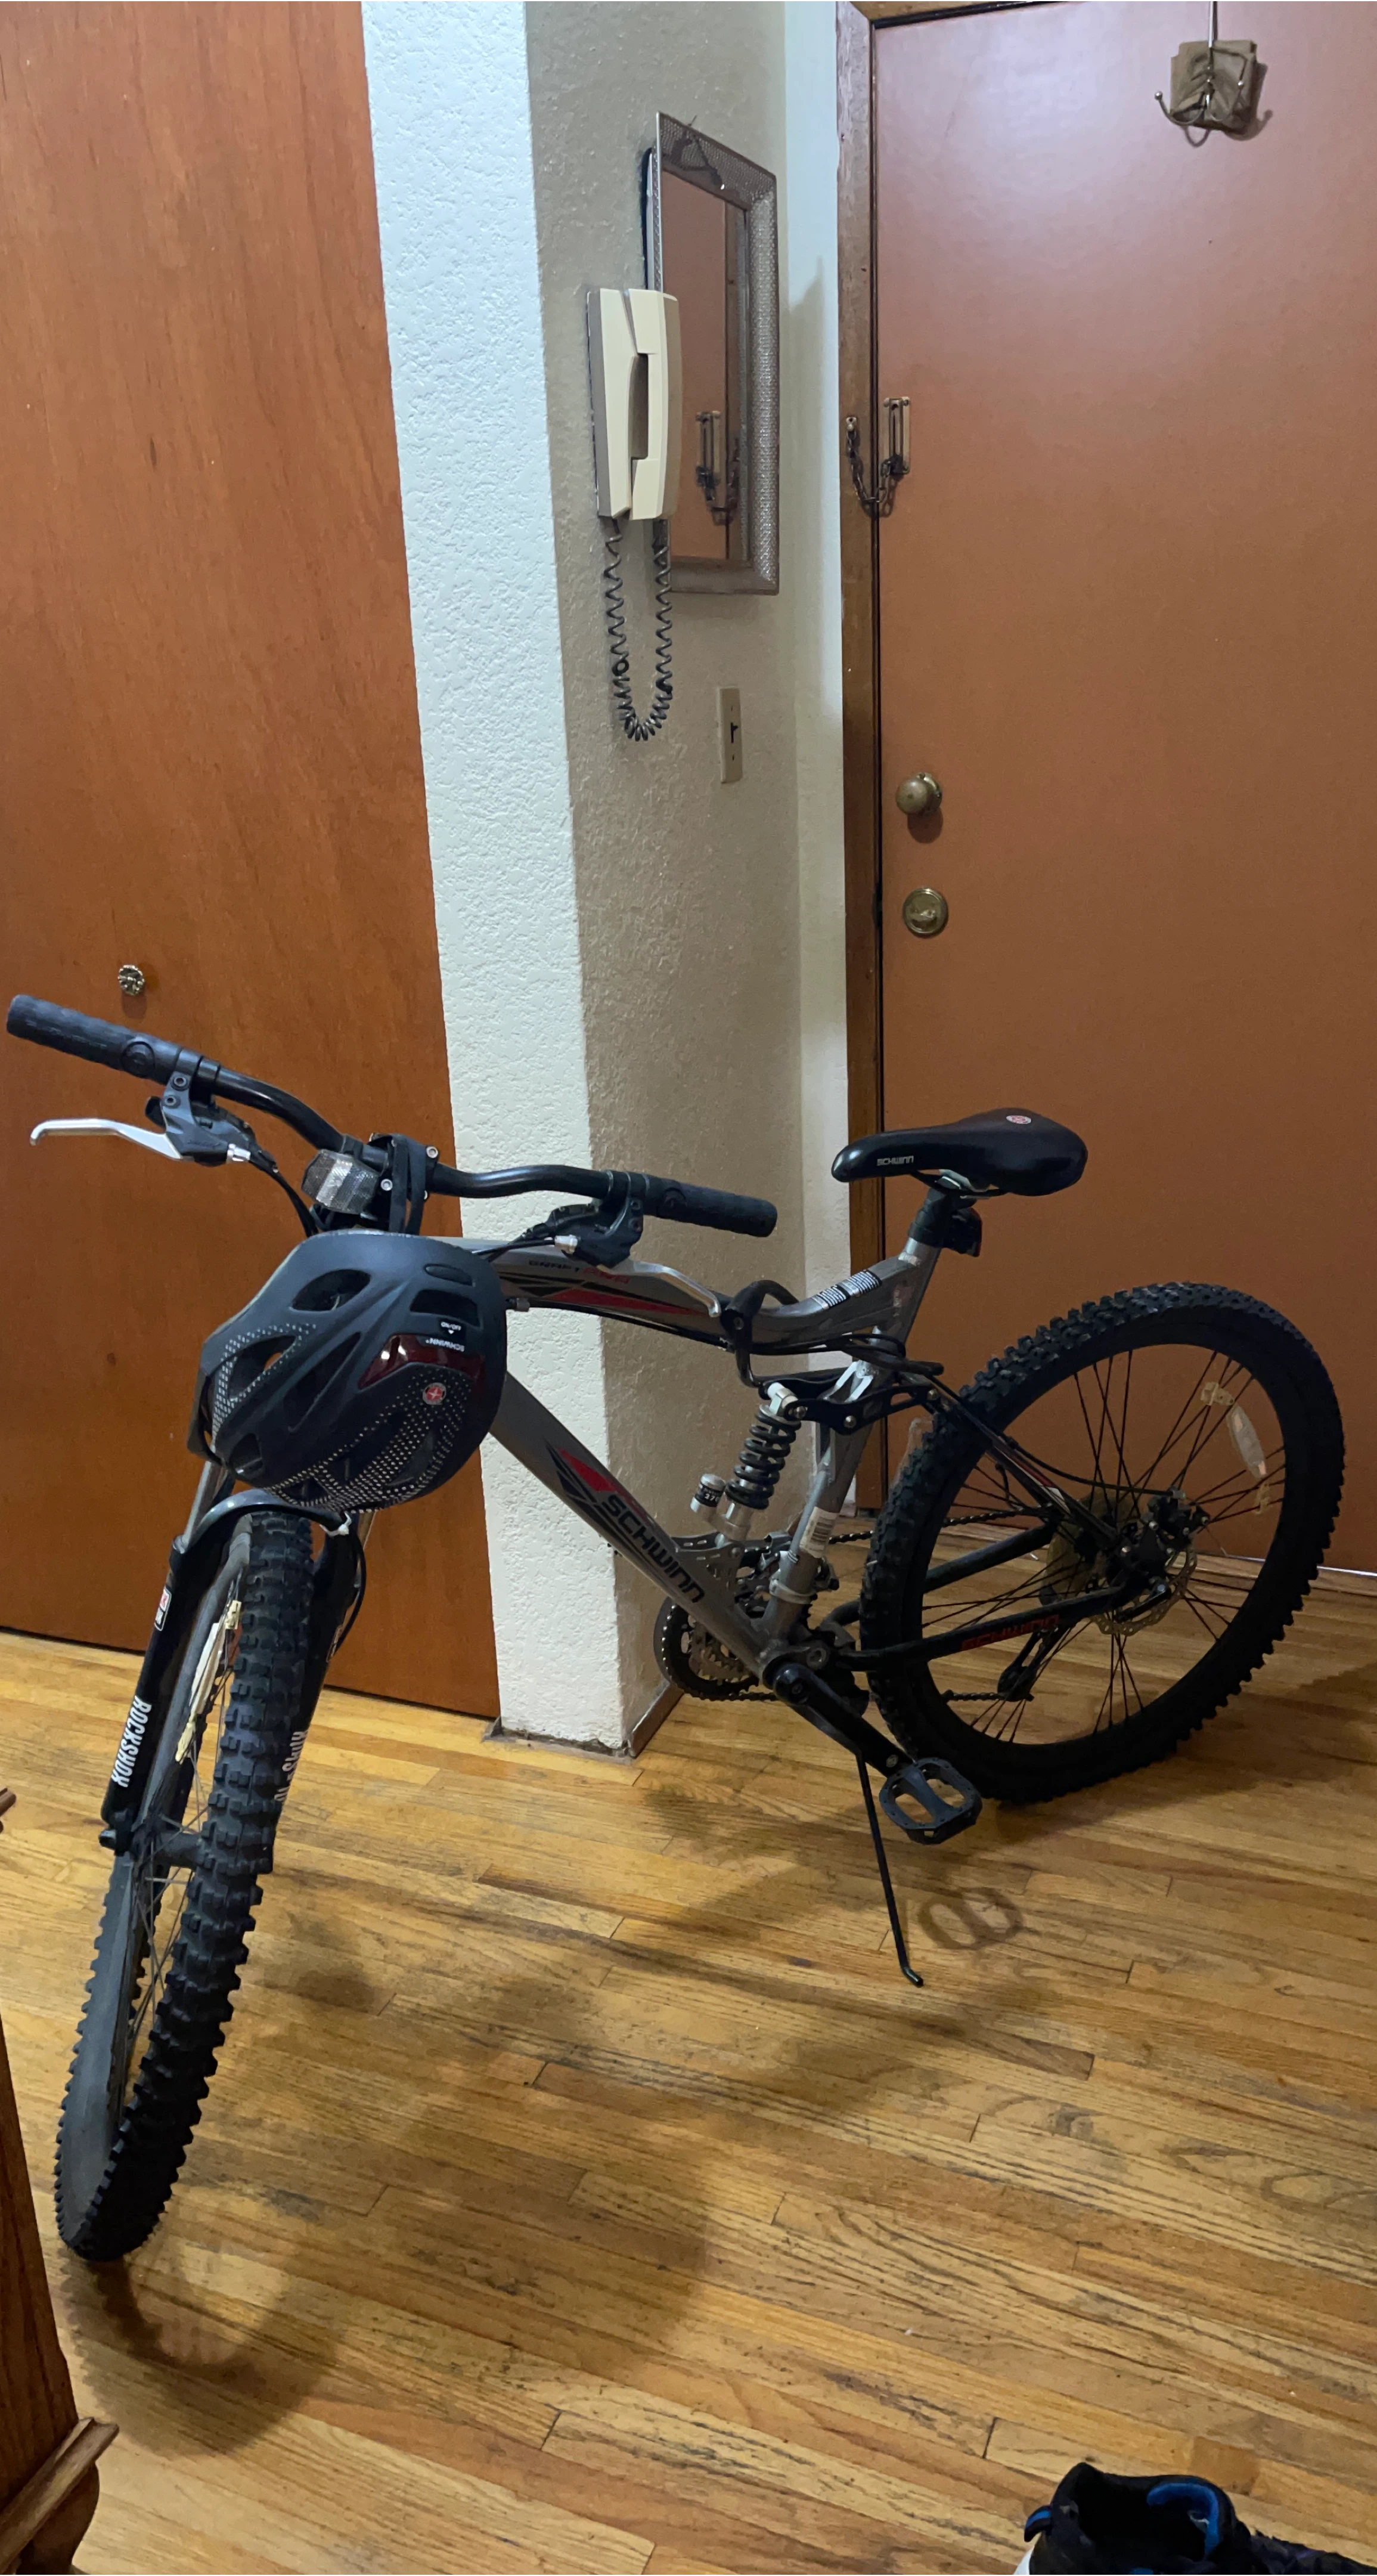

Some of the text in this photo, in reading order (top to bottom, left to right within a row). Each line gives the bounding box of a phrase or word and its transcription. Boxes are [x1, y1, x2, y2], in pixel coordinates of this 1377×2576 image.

[877, 1156, 914, 1166] SCHWINN
[603, 1494, 705, 1603] SCHWINN
[111, 1696, 151, 1788] ROCKSHOX
